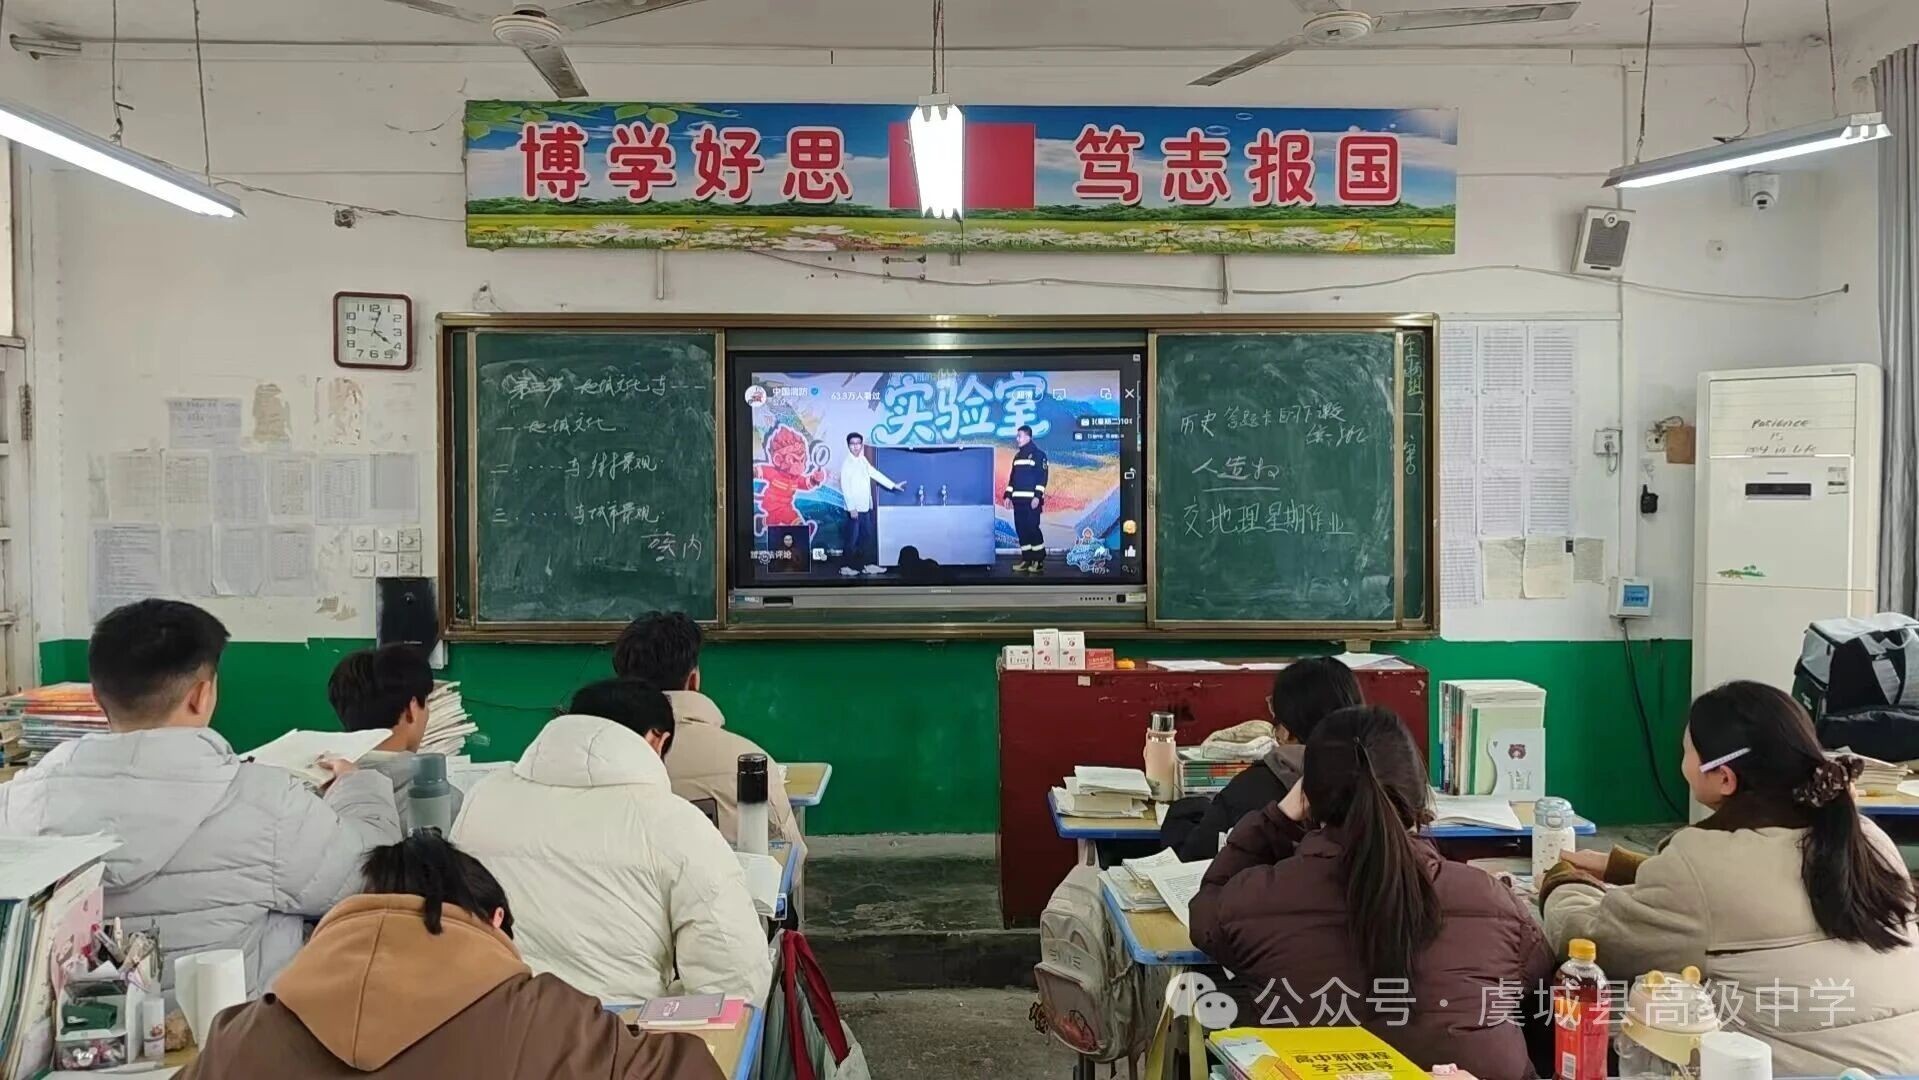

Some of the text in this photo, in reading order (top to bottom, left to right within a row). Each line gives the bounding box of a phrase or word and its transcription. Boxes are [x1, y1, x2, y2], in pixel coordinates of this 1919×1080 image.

[520, 122, 1400, 206] 博学好思 笃志报国
[874, 371, 1050, 446] 实验室
[1180, 409, 1217, 437] 历史
[1184, 496, 1355, 538] 交地理星期作业
